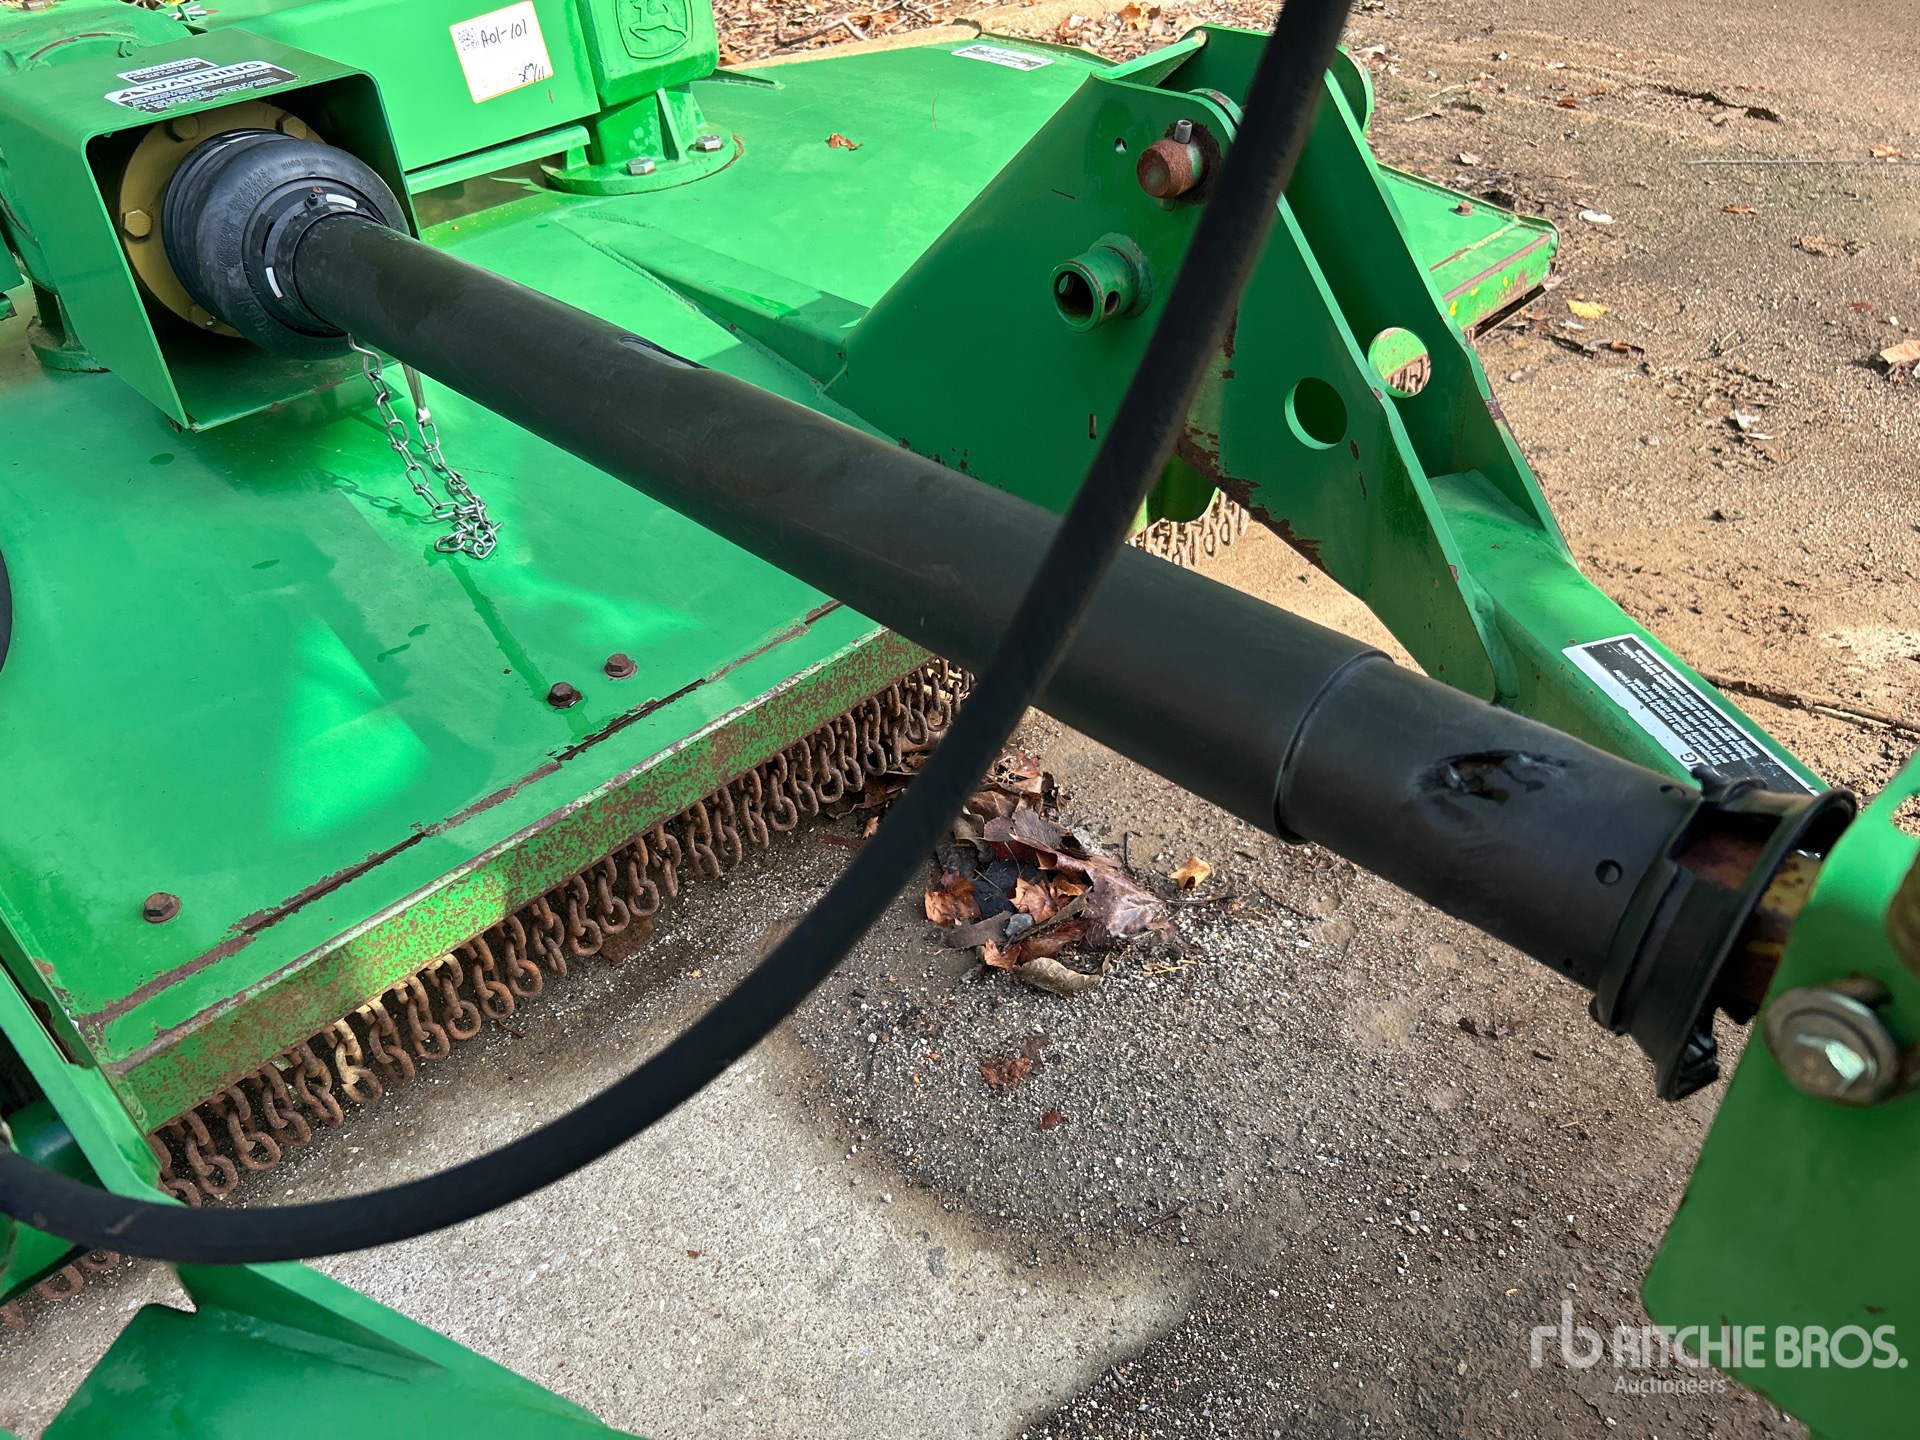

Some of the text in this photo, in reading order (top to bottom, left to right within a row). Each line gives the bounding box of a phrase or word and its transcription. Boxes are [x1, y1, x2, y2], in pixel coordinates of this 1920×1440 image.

[480, 18, 528, 48] A01-101
[145, 63, 263, 91] WARNING
[1672, 723, 1686, 734] with
[1686, 715, 1700, 725] with
[1691, 731, 1716, 750] properly
[1696, 725, 1723, 746] transport
[1711, 727, 1731, 741] speed
[1693, 743, 1721, 766] Transport
[1719, 745, 1732, 754] not
